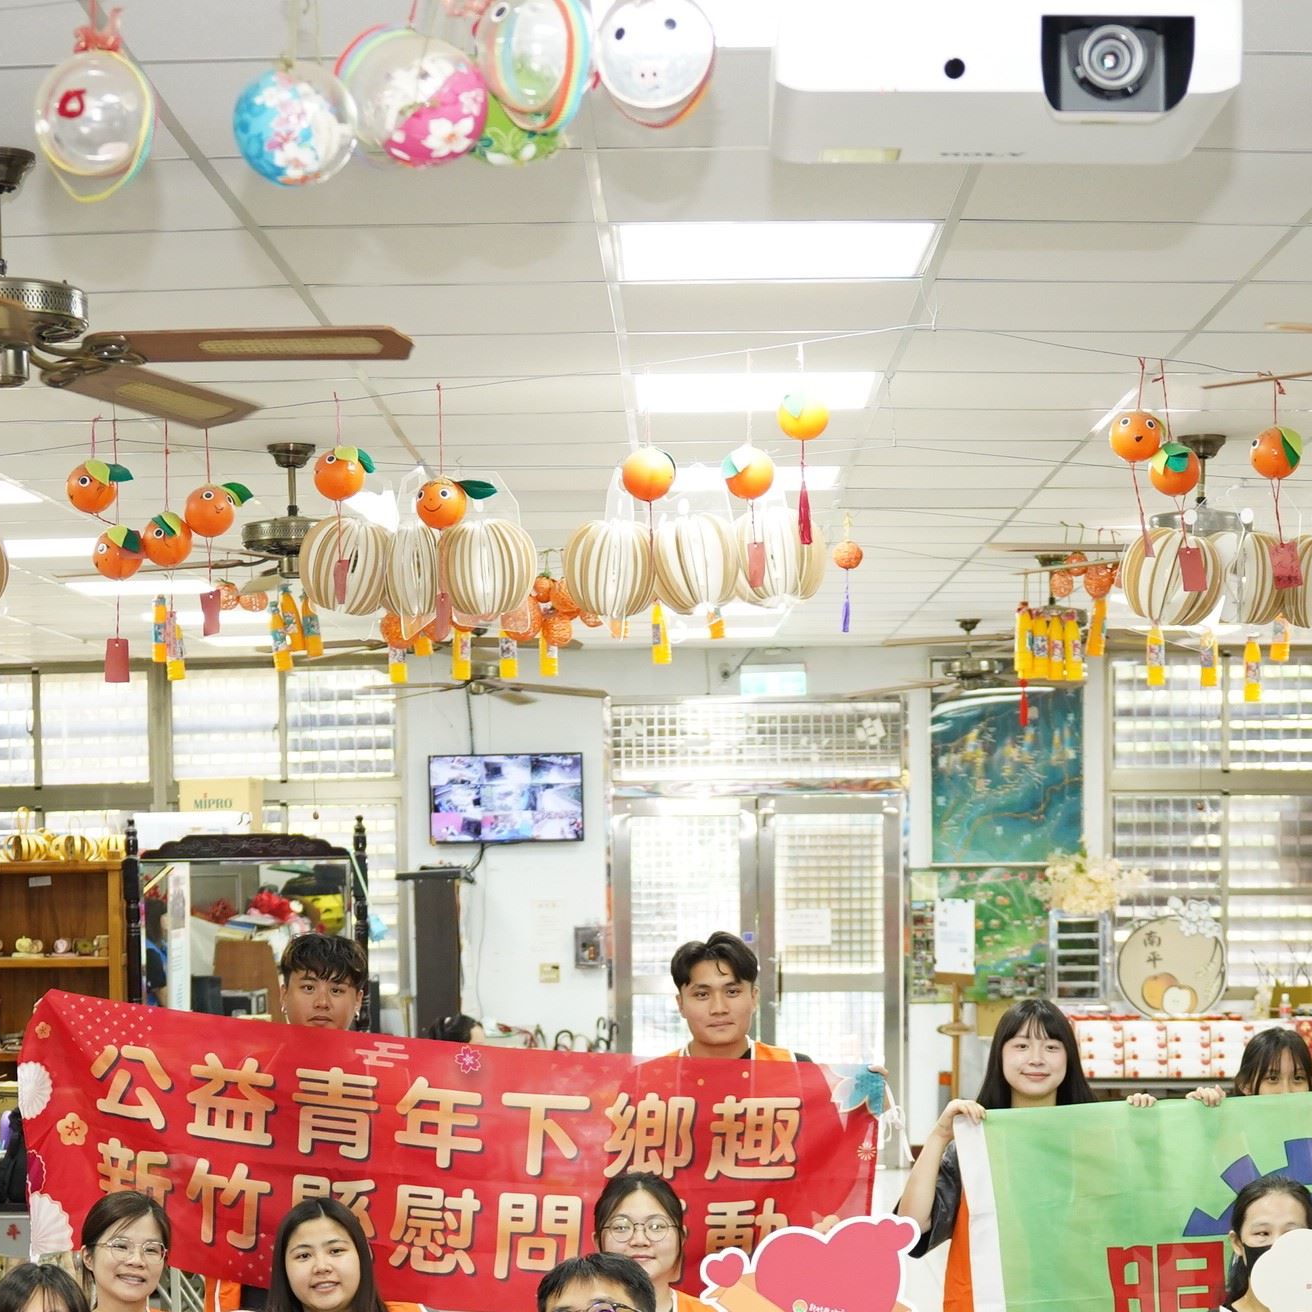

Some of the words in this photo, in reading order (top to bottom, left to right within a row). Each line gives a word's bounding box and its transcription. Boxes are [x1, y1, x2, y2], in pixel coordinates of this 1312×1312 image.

[1144, 931, 1163, 968] 南平
[91, 1044, 802, 1180] 公益青年下鄉趣
